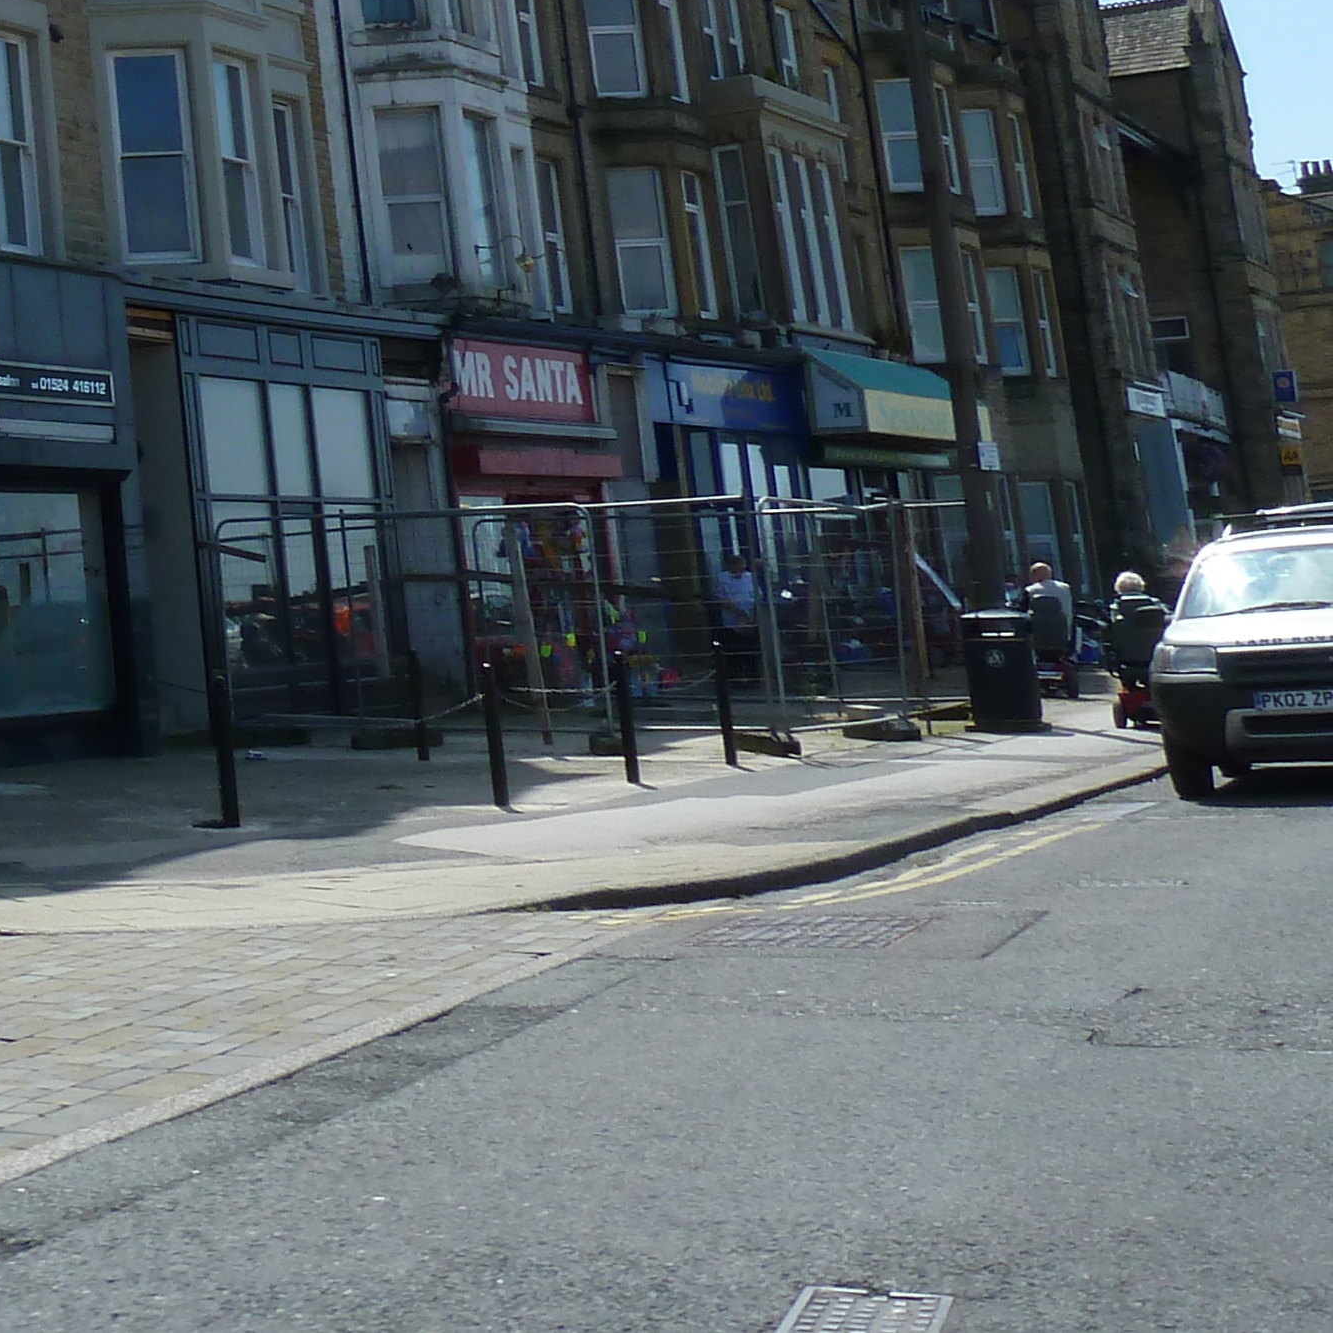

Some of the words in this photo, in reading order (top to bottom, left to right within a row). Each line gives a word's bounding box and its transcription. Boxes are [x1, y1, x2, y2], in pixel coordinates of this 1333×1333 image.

[39, 377, 69, 392] 01524
[72, 380, 107, 395] 416112
[453, 350, 495, 399] MR
[503, 355, 584, 405] SANTA
[1261, 691, 1307, 709] PK02
[1312, 690, 1333, 706] ZP
